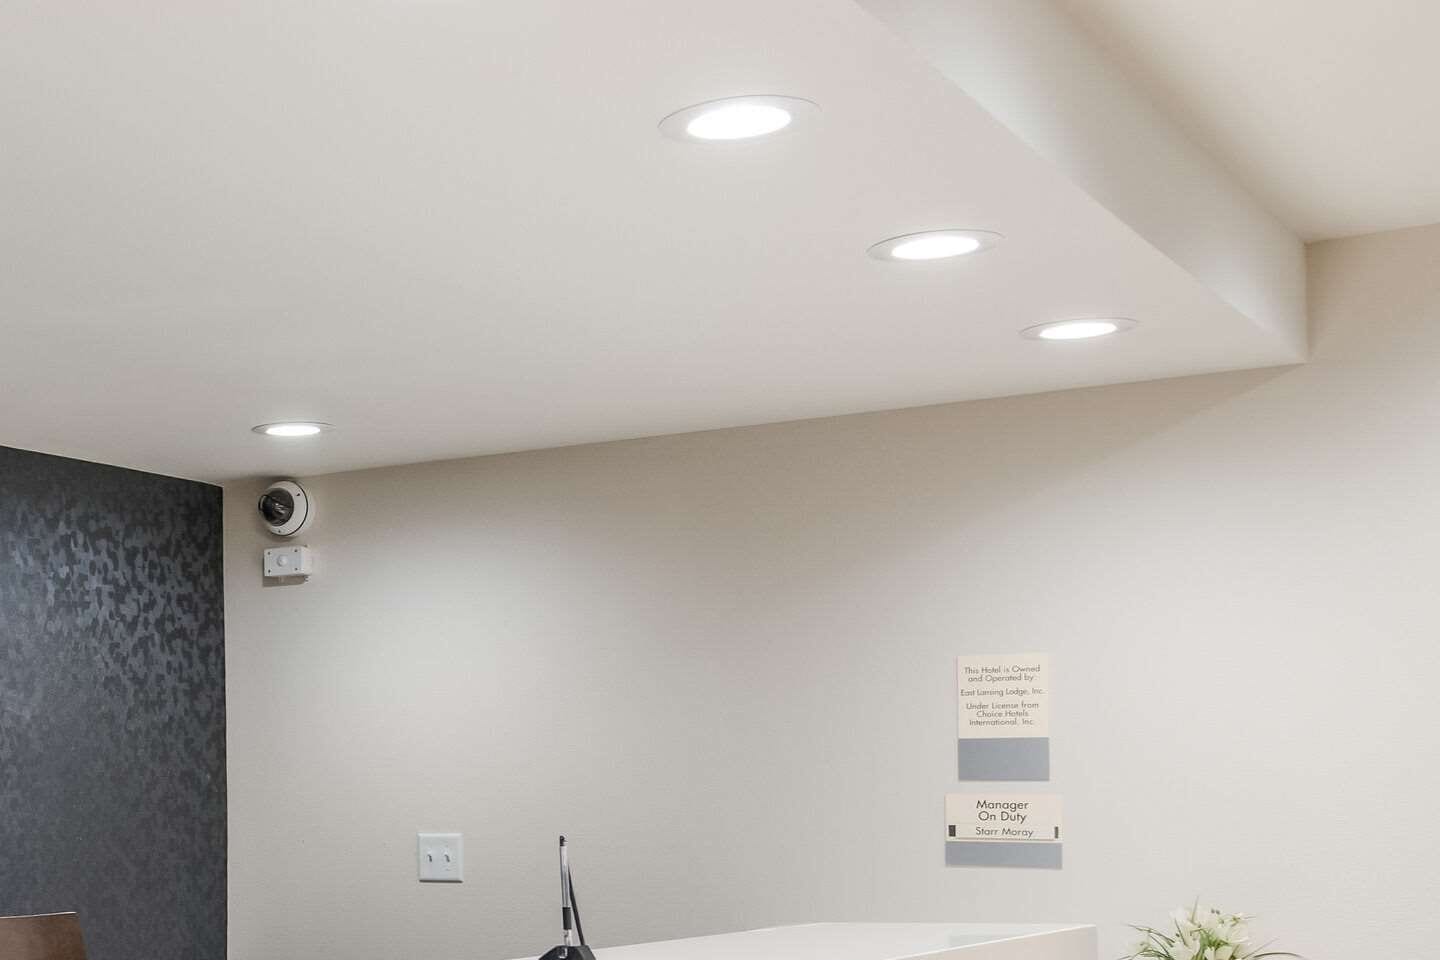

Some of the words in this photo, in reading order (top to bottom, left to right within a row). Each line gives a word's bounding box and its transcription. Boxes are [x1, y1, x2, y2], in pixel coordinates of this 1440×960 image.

[964, 666, 979, 674] This
[981, 665, 1001, 674] Hotel
[1012, 664, 1041, 673] Owned
[968, 675, 983, 683] and
[984, 673, 1022, 683] Operated
[991, 702, 1019, 710] License
[1021, 701, 1039, 709] from
[976, 710, 1003, 718] Choice
[1005, 709, 1029, 717] Hotels
[976, 800, 1030, 812] Manager
[978, 811, 996, 821] On
[1001, 811, 1027, 824] Duty
[976, 827, 998, 836] Starr
